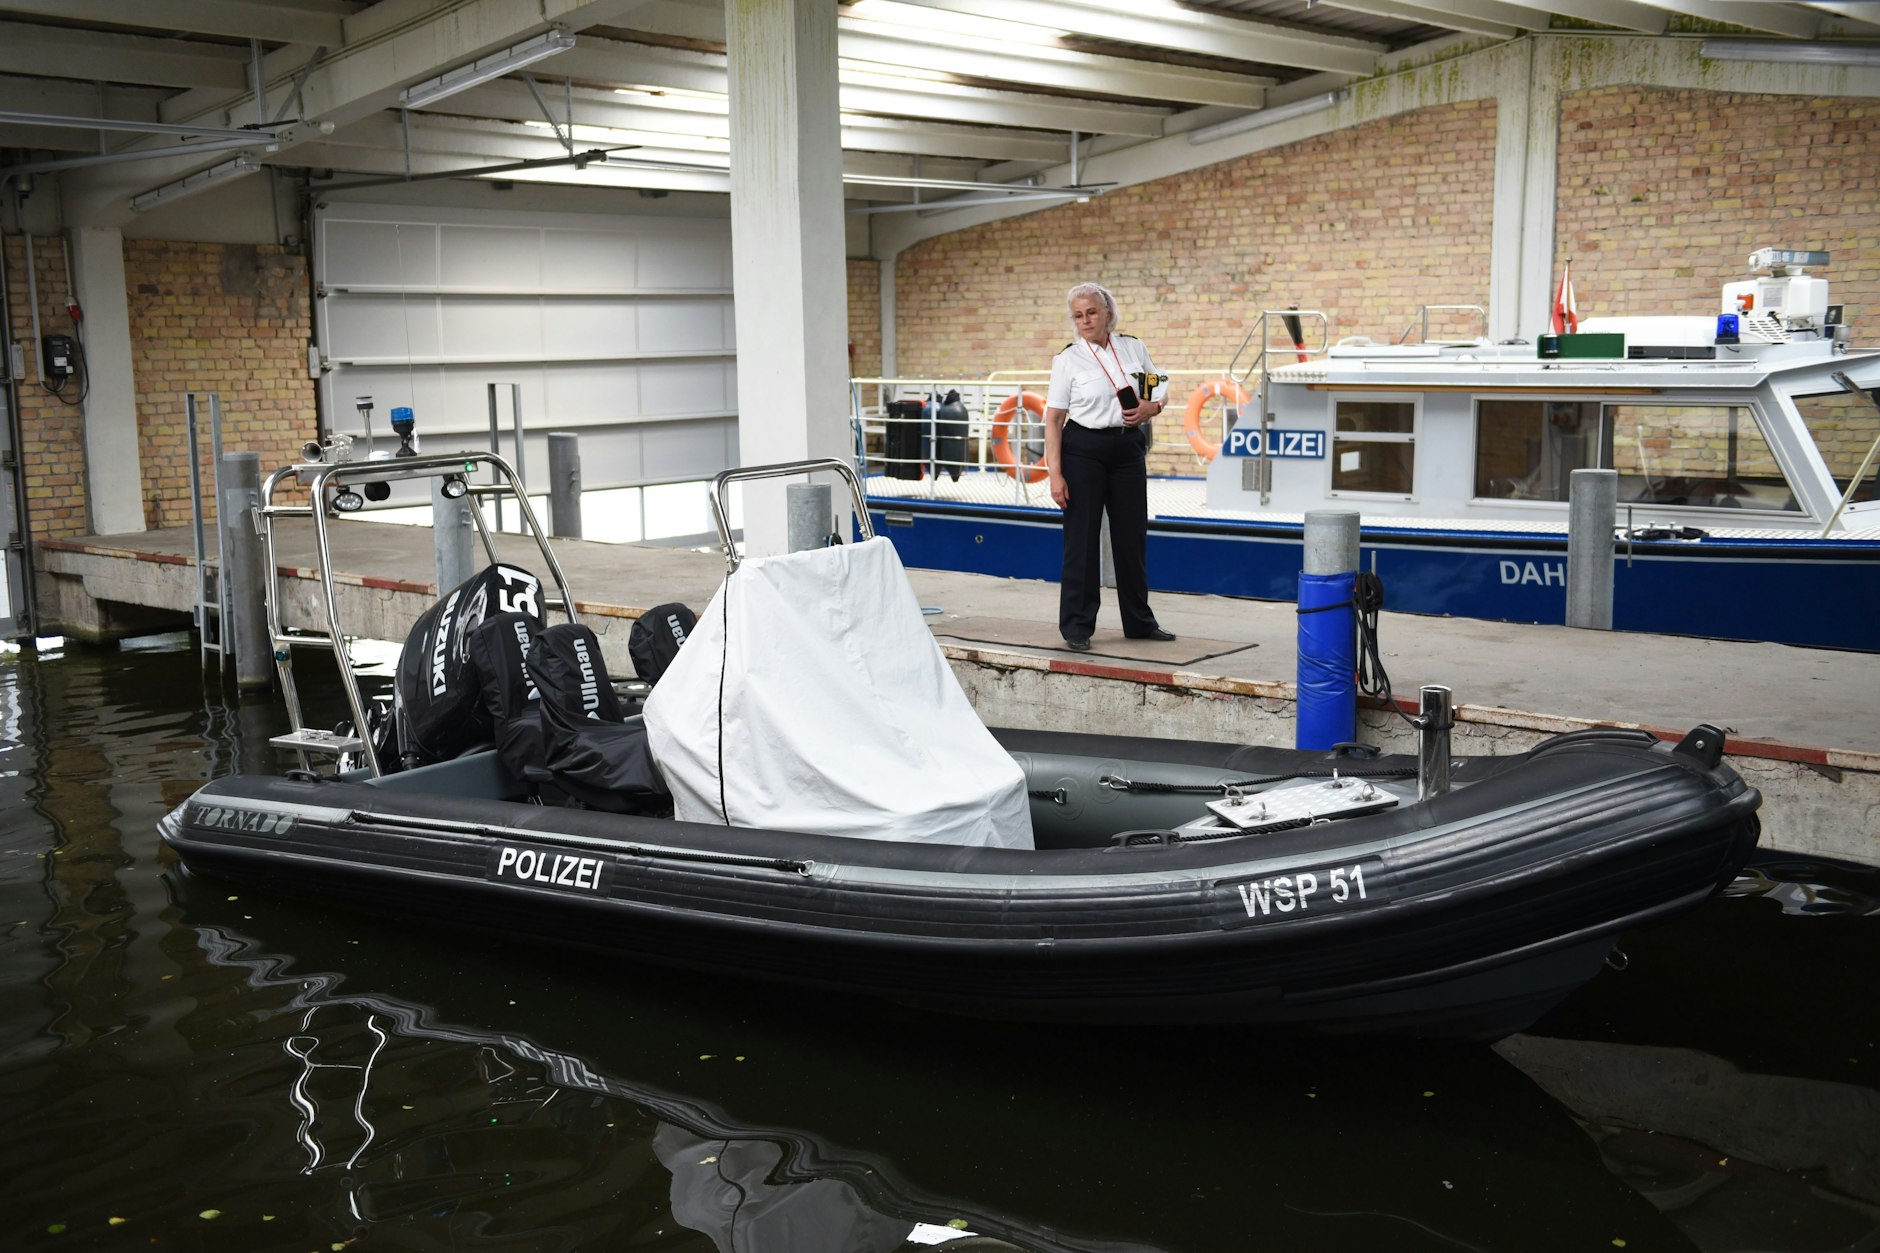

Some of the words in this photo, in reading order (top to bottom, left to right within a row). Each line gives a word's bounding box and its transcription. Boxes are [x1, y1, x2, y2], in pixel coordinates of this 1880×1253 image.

[1230, 431, 1324, 457] POLIZEI
[497, 566, 539, 618] 51
[1500, 560, 1568, 587] DAH
[433, 589, 461, 697] SUZUKI
[573, 638, 600, 710] Ullman
[193, 806, 294, 835] TORNADO
[497, 847, 604, 890] POLIZEI
[1238, 873, 1318, 918] WSP
[1330, 864, 1367, 904] 51
